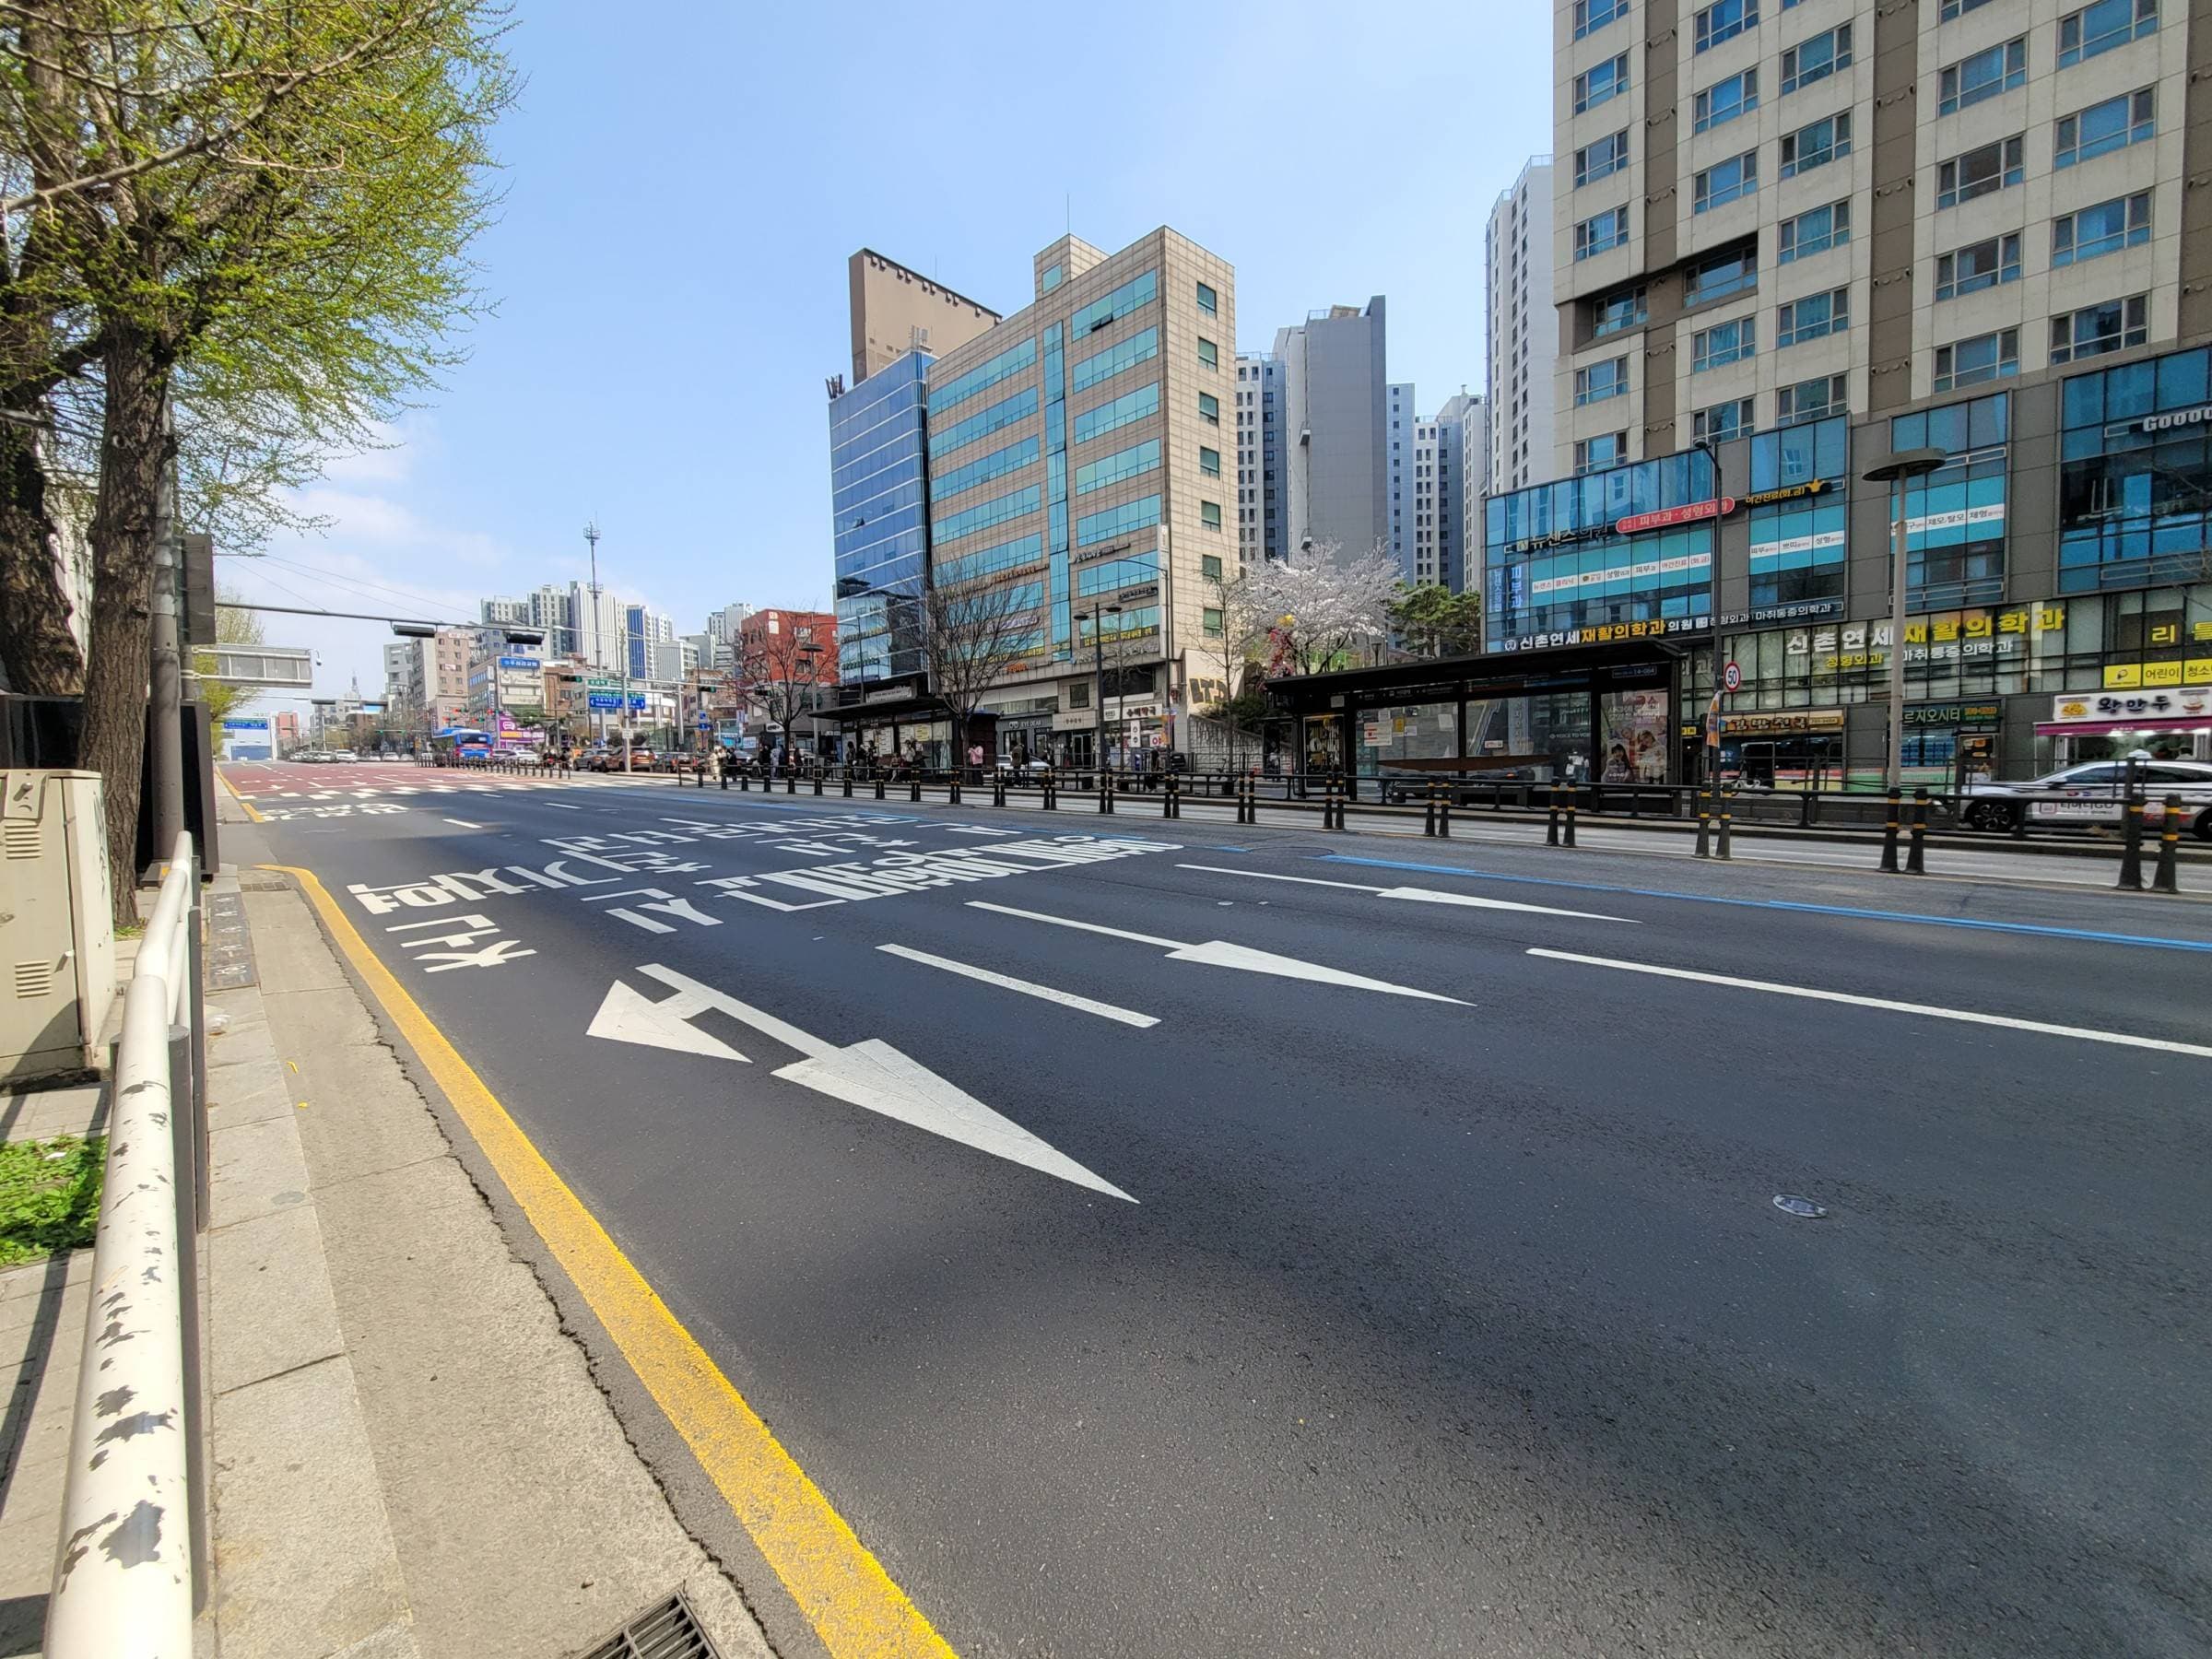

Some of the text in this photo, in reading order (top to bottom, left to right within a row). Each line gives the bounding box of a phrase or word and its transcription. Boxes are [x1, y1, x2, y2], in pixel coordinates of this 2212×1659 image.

[1511, 565, 1523, 609] 피부과
[1826, 653, 1884, 668] 정형외과
[1728, 670, 1736, 685] 50
[2146, 667, 2180, 680] 어린이
[2187, 664, 2212, 677] 청소
[2097, 695, 2171, 715] 왕만두
[1902, 707, 1960, 724] 르지오시티
[1731, 716, 1807, 731] 김밥천국
